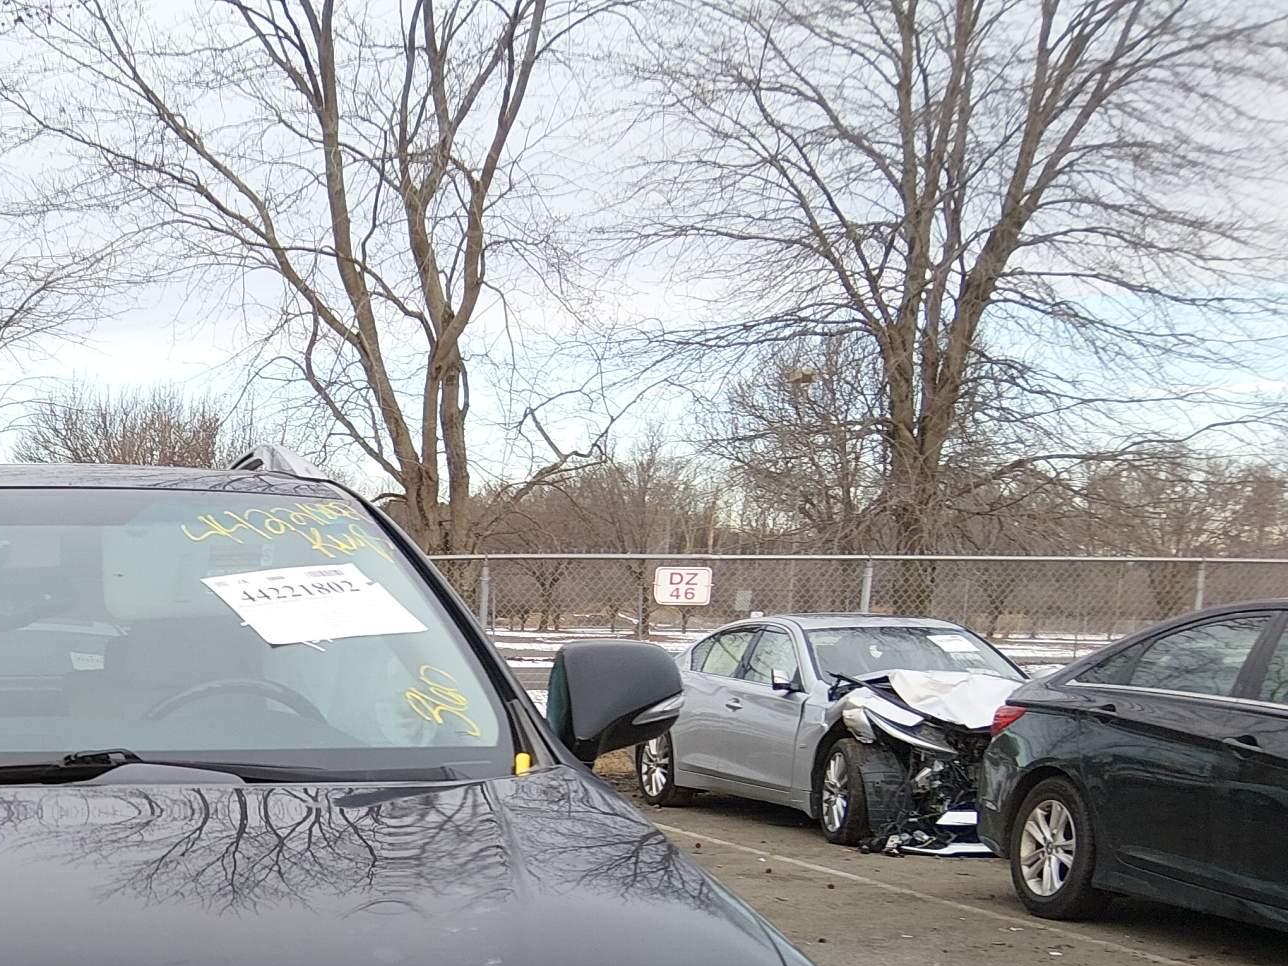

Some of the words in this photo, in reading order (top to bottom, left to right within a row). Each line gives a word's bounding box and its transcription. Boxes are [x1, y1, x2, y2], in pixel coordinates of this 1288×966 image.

[669, 572, 698, 586] DZ
[241, 580, 361, 602] 44221802
[669, 587, 696, 600] 46
